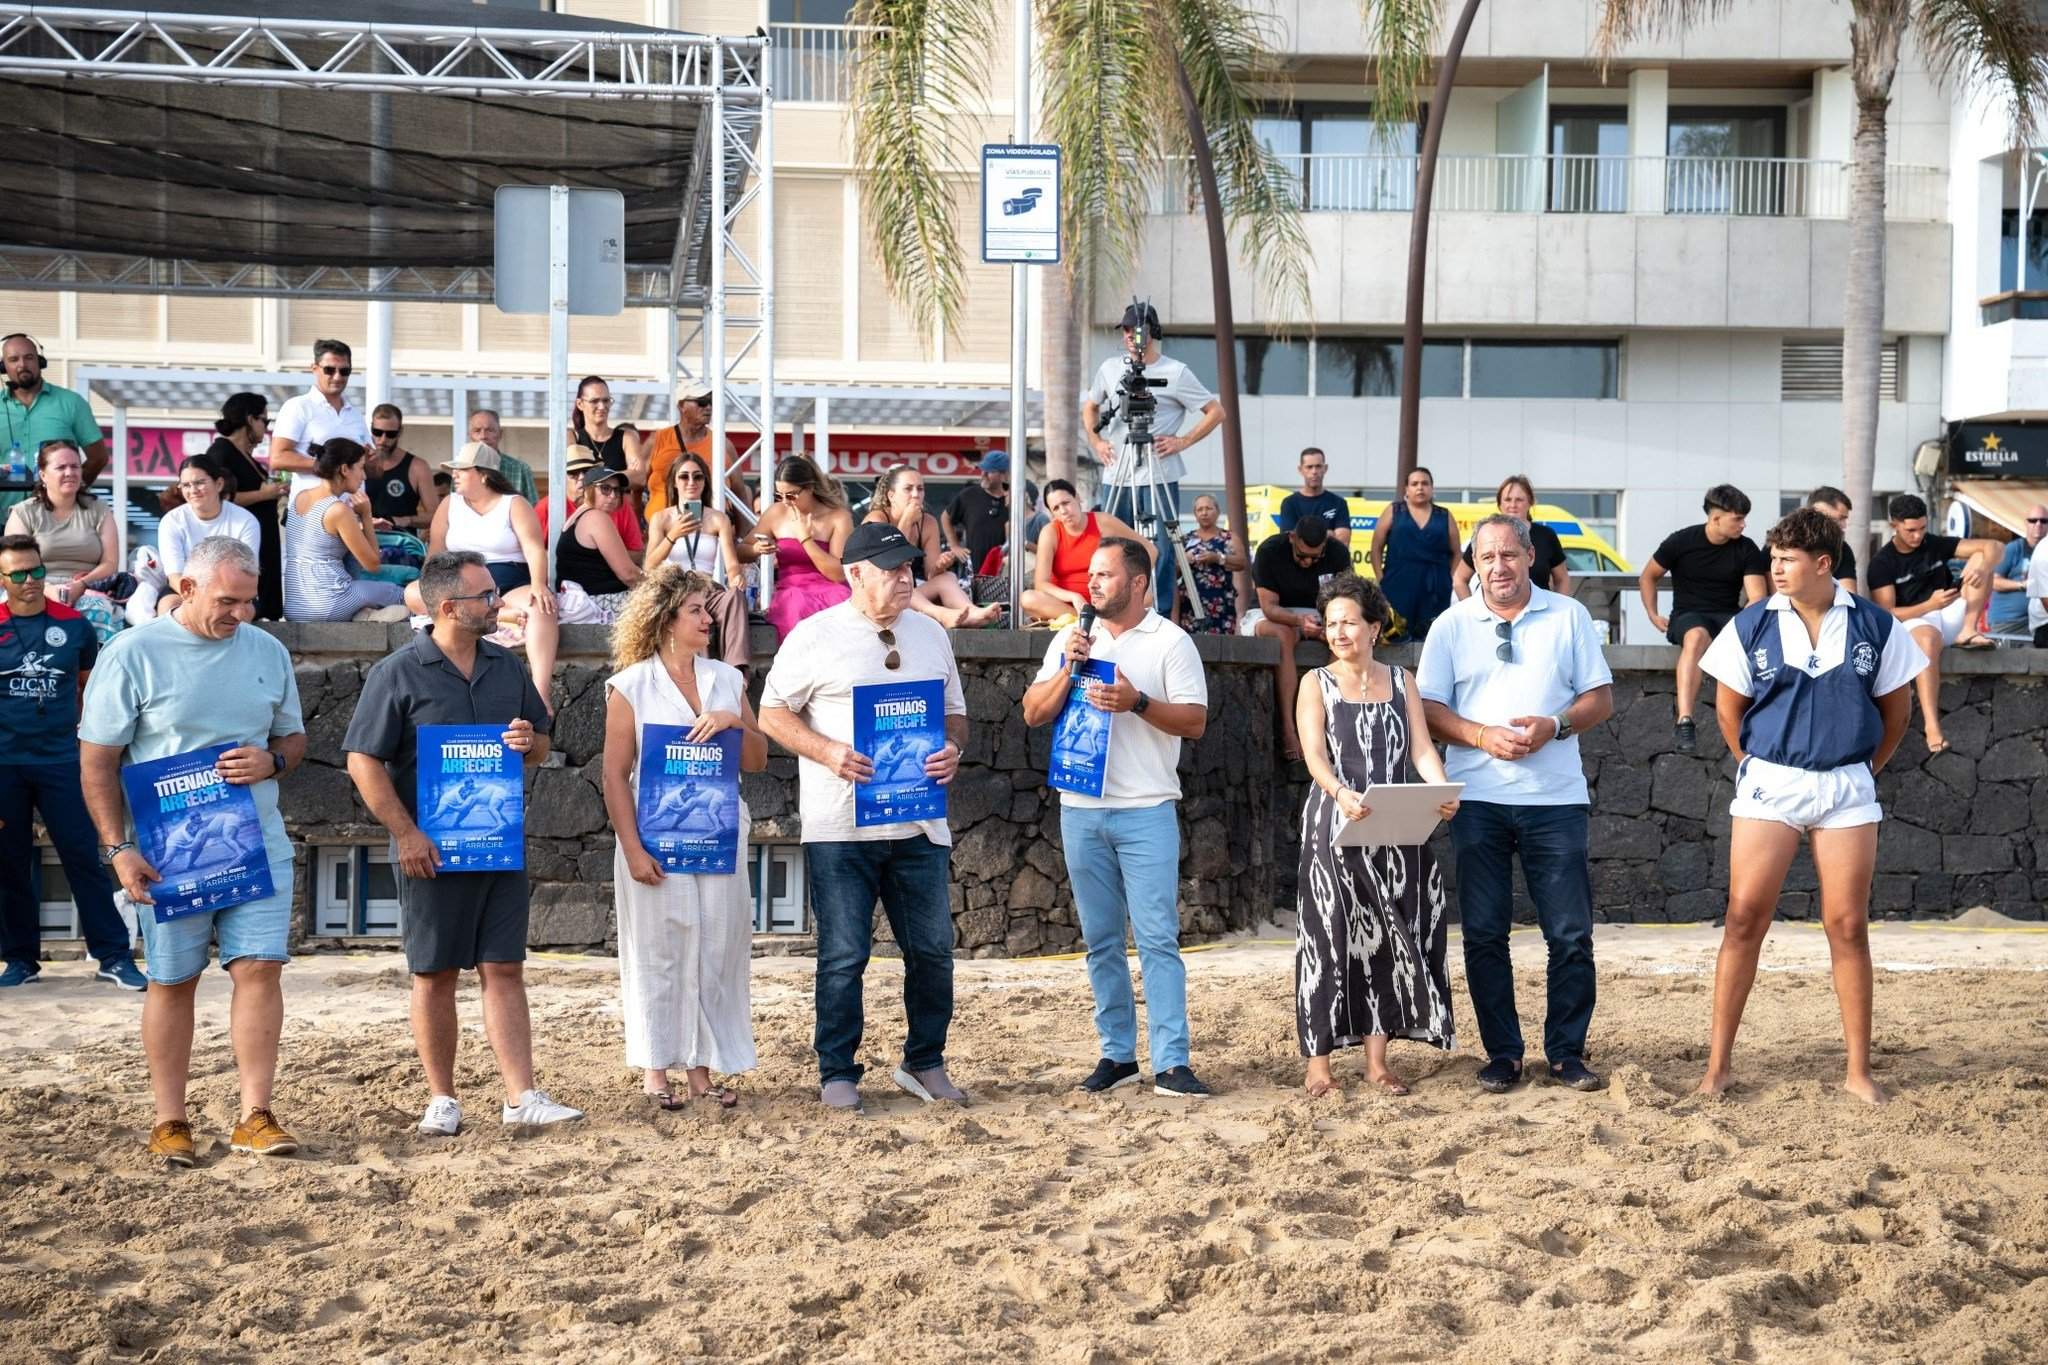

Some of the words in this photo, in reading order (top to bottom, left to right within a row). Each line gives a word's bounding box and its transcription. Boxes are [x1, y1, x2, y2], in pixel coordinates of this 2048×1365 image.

[1965, 451, 2018, 461] ESTRELLA
[9, 677, 57, 691] CICAR
[874, 700, 927, 717] TITENAOS
[875, 713, 927, 731] ARRECIFE
[441, 744, 503, 758] TITENAOS
[665, 745, 723, 761] TITENAOS
[441, 759, 503, 773] ARRECIFE
[664, 760, 722, 776] ARRECIFE
[154, 768, 224, 797] TITENAOS
[160, 783, 230, 813] ARRECIFE
[206, 871, 248, 887] ARRECIFE
